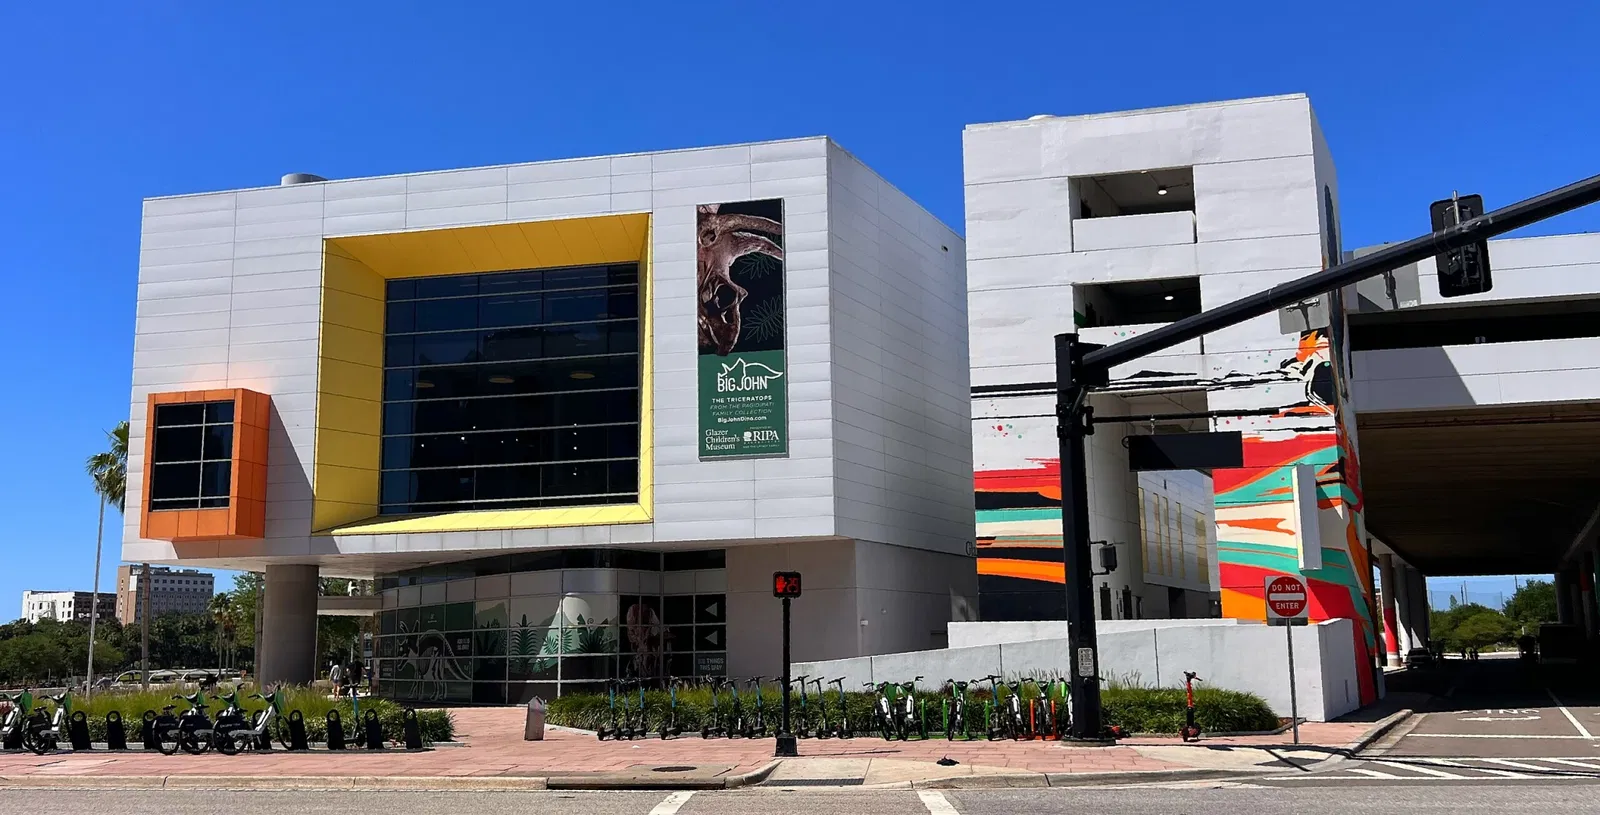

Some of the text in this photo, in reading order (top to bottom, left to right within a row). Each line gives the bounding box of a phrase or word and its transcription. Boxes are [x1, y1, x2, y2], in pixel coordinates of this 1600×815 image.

[736, 376, 768, 391] JOHN
[705, 428, 729, 437] Glazer
[752, 430, 779, 441] RIPA
[705, 434, 740, 444] Children's
[705, 443, 736, 451] Museum
